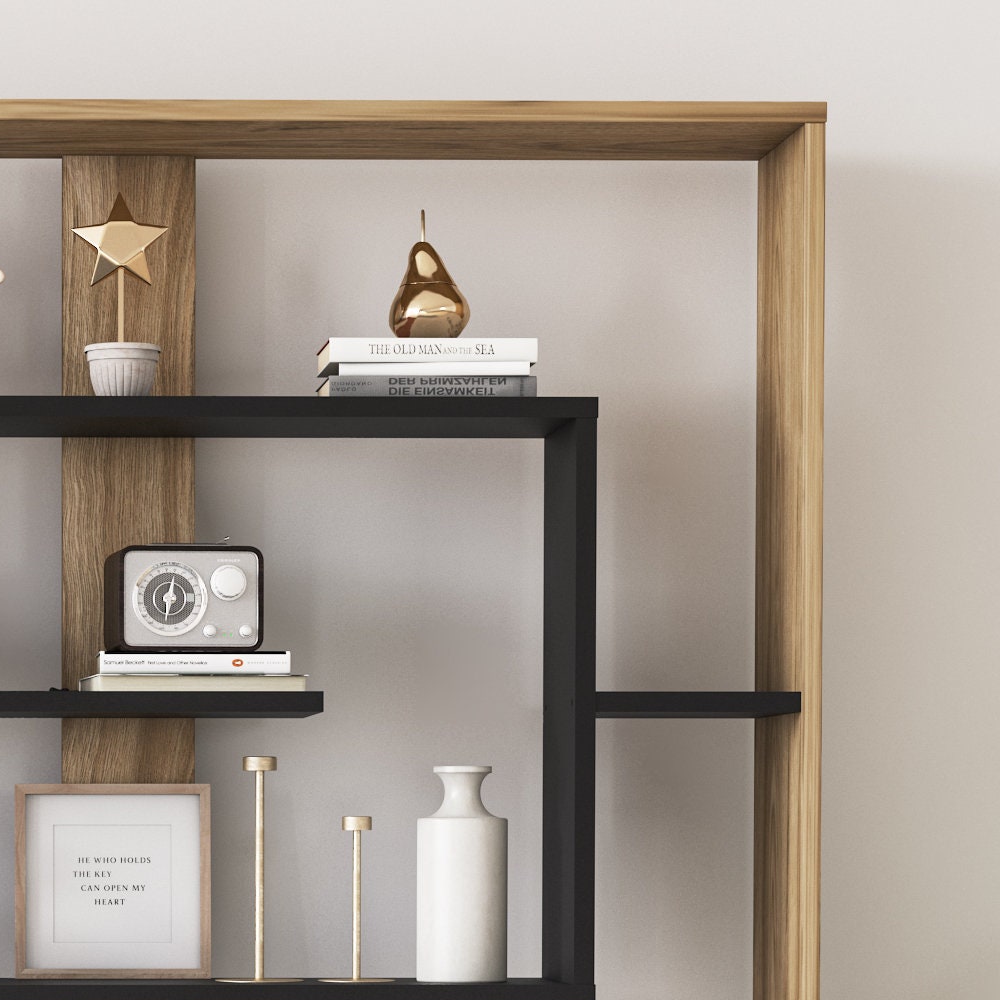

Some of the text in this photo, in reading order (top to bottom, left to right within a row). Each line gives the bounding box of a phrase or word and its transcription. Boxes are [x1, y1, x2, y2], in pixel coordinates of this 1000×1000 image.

[368, 343, 495, 355] THE OLD MAN AND THE SEA
